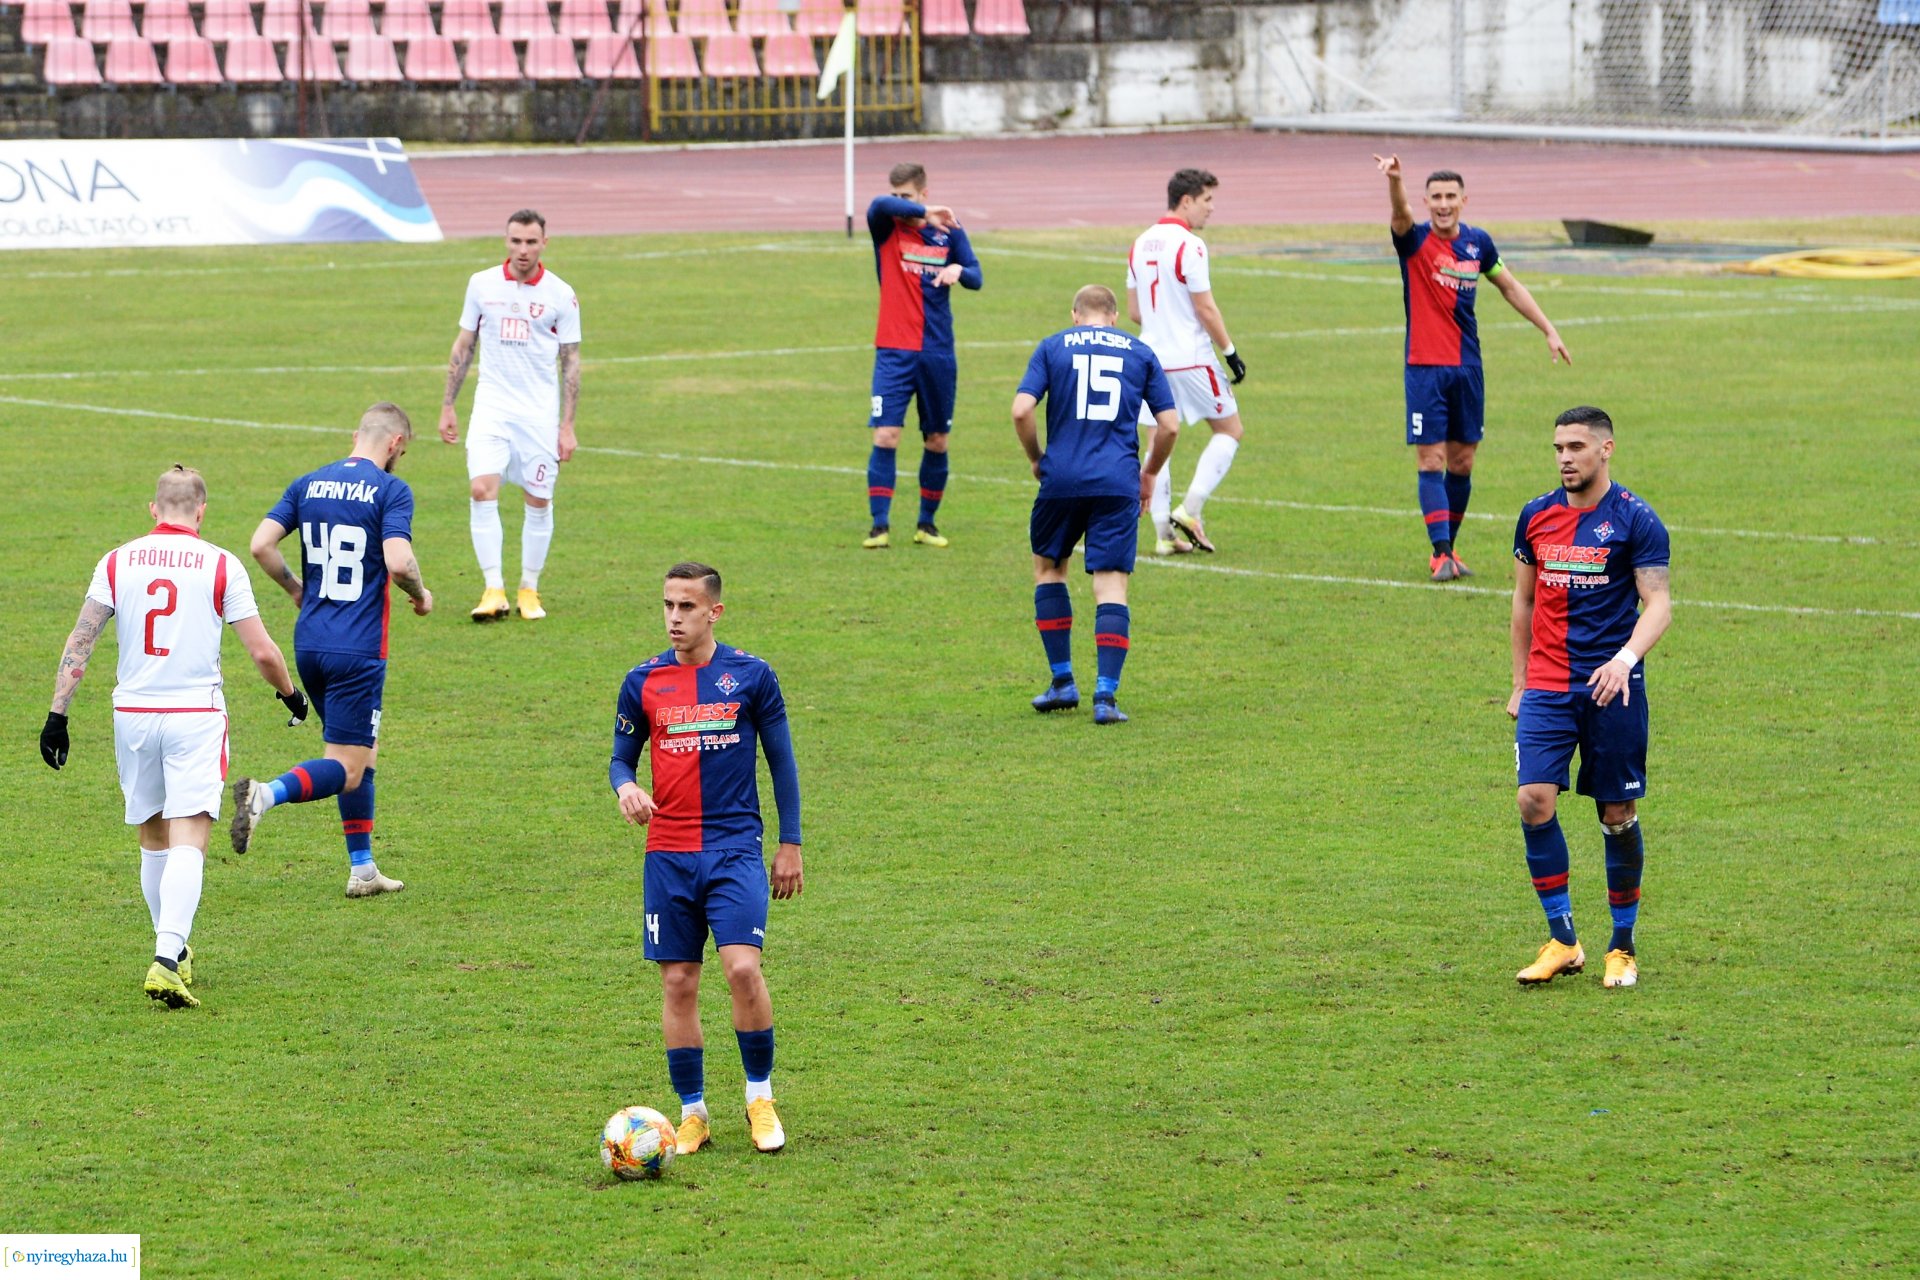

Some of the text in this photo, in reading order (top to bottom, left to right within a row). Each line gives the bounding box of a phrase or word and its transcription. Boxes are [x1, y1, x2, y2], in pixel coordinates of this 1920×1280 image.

[0, 214, 148, 236] OLGÁLTATÓ
[1146, 260, 1159, 313] 7
[1064, 331, 1132, 350] PAPUCSEK
[1072, 353, 1123, 422] 15
[1412, 412, 1423, 436] 5
[536, 464, 546, 481] 6
[305, 480, 378, 503] HORNYÁK
[129, 547, 204, 569] FRÖHLICH
[302, 522, 367, 601] 48
[1537, 544, 1611, 564] REVESZ
[1572, 575, 1610, 585] TRANS
[144, 578, 177, 656] 2
[656, 702, 741, 726] REVESZ
[702, 733, 740, 745] TRANS
